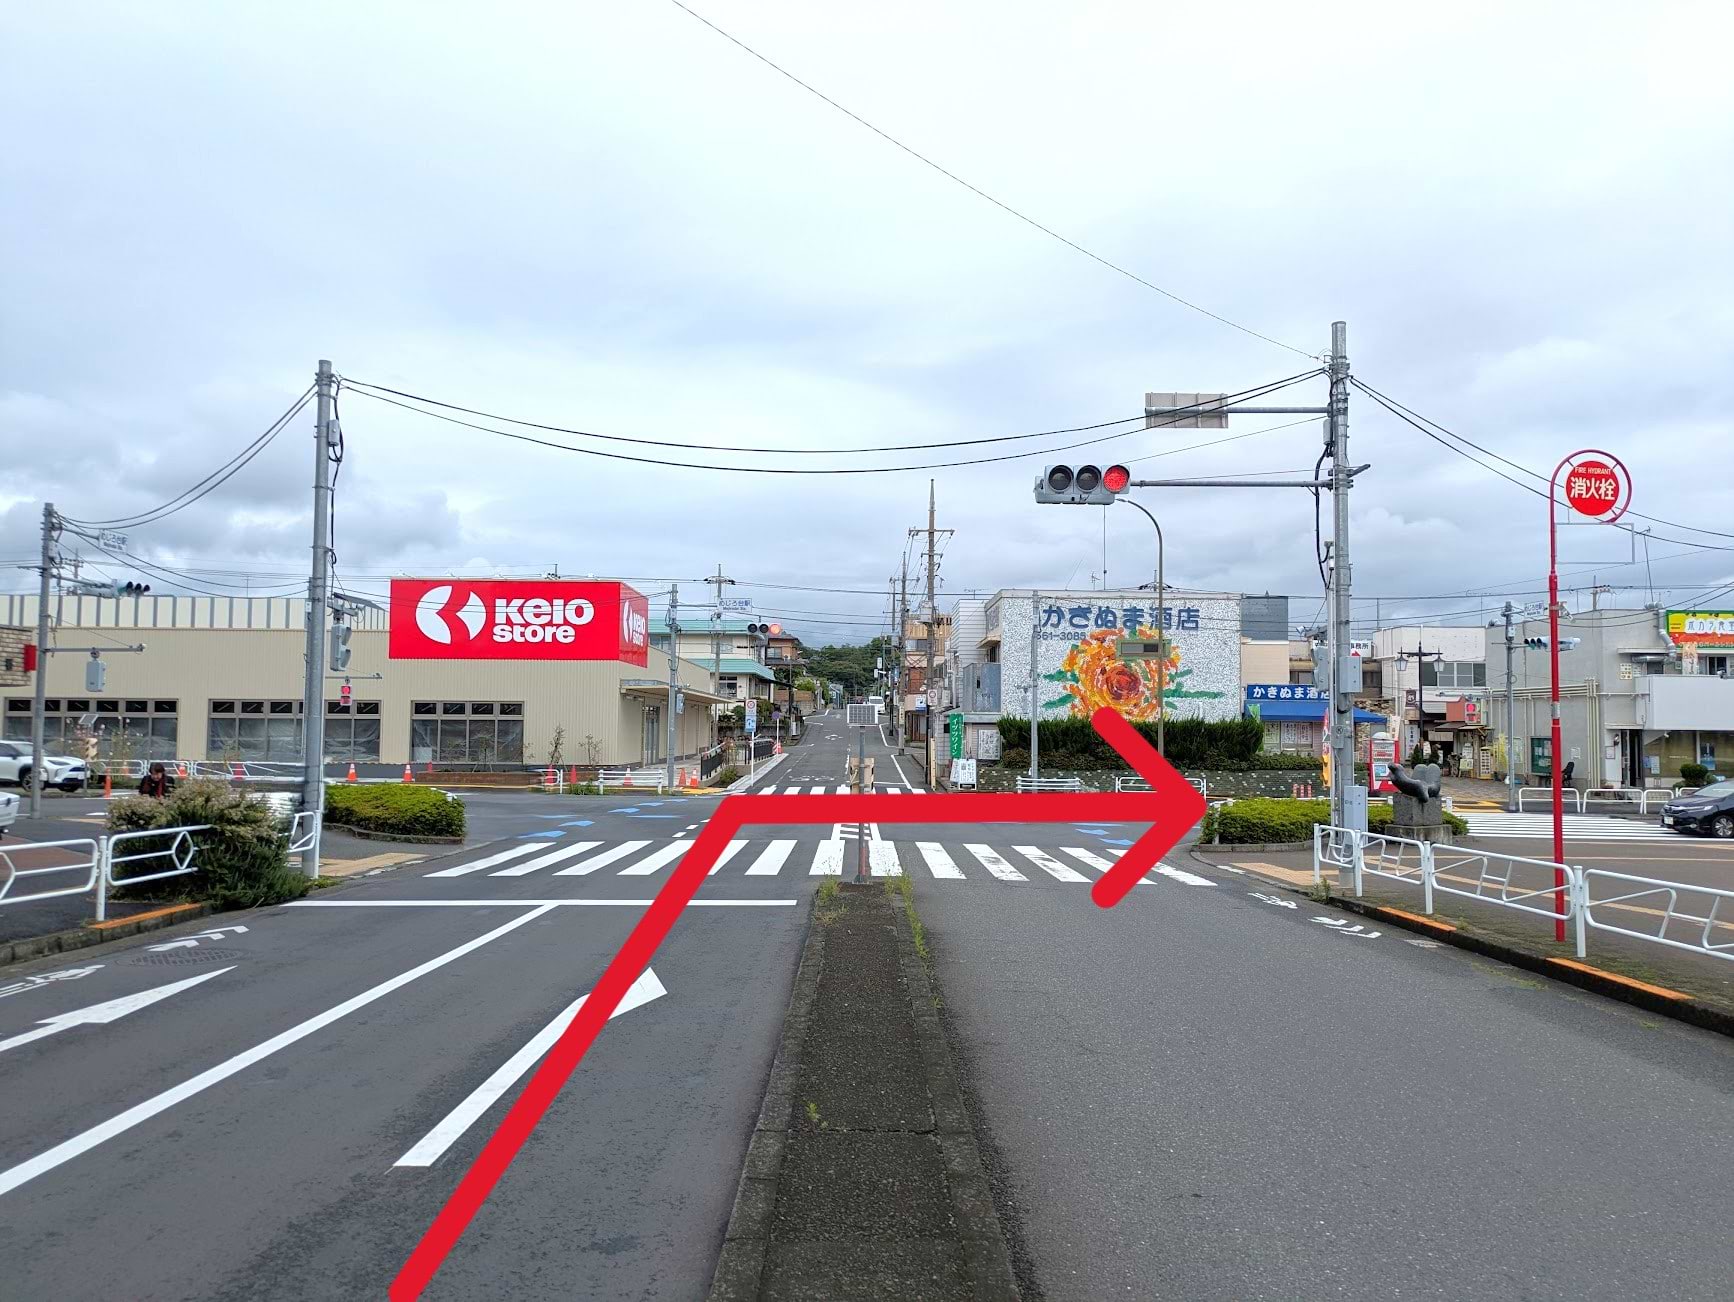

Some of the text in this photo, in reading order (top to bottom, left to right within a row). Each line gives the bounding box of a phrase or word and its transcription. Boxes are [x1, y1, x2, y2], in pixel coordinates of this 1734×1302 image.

[1570, 477, 1617, 500] 消火栓
[492, 625, 576, 643] store
